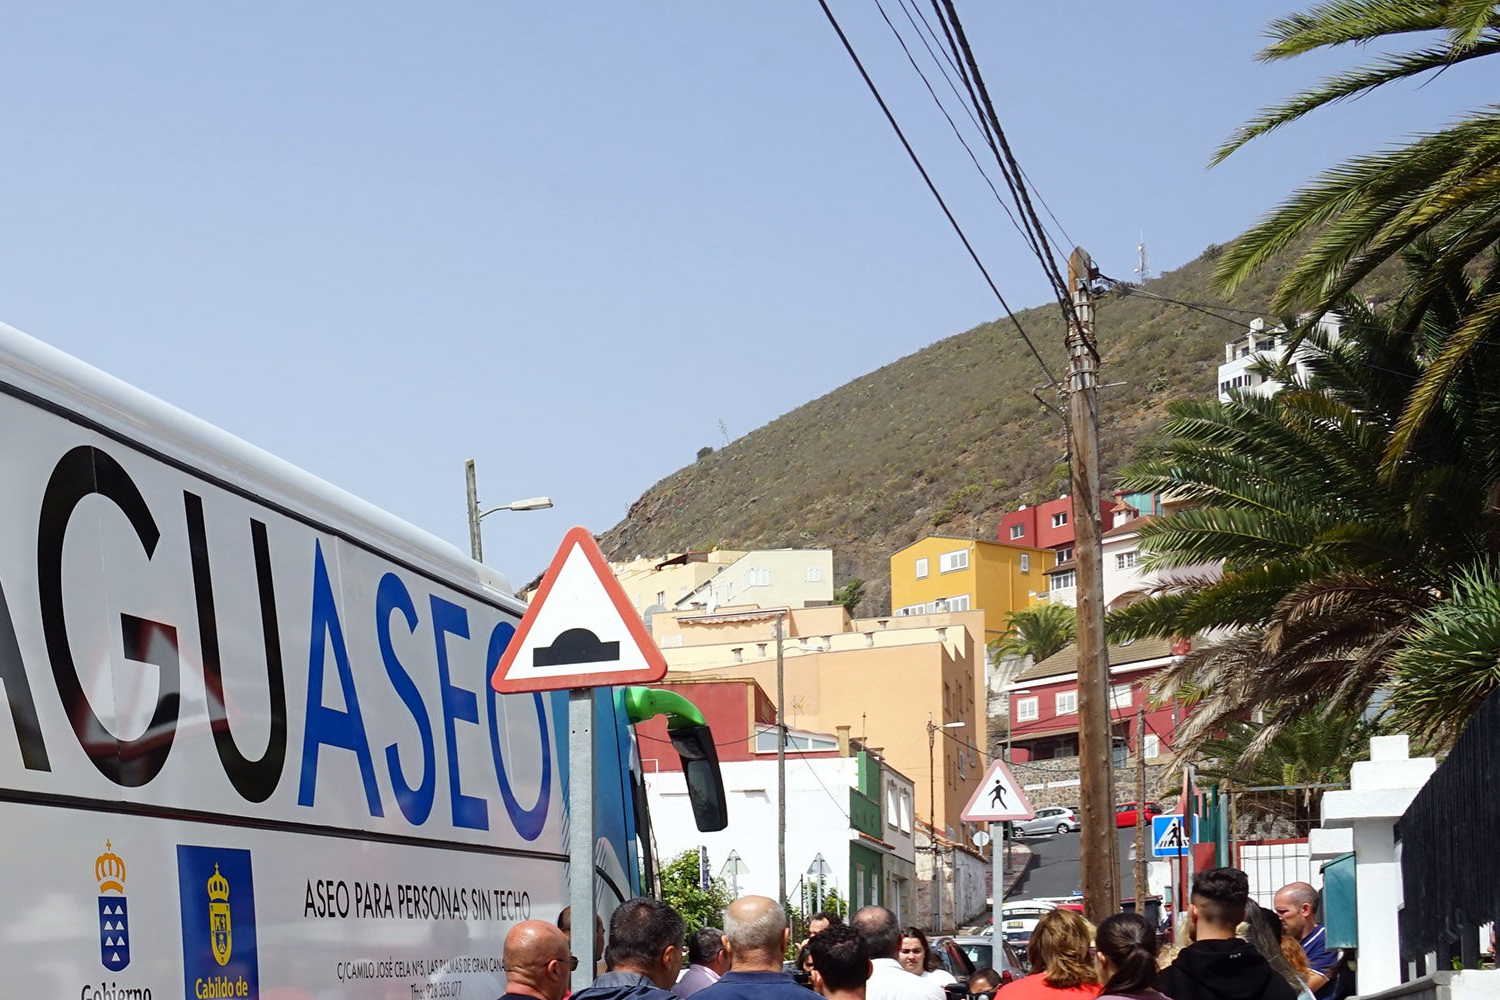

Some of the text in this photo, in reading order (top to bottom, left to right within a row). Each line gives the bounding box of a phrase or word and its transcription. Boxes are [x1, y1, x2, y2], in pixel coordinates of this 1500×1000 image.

[304, 878, 531, 922] ASEO PARA PERSONAS SIN TECHO
[376, 955, 393, 979] JOSÉ
[394, 961, 411, 978] CELA
[427, 958, 439, 976] LAS
[463, 957, 471, 974] DE
[471, 957, 489, 973] GRAN
[489, 957, 506, 972] CANA
[196, 975, 249, 1000] Cabildo de
